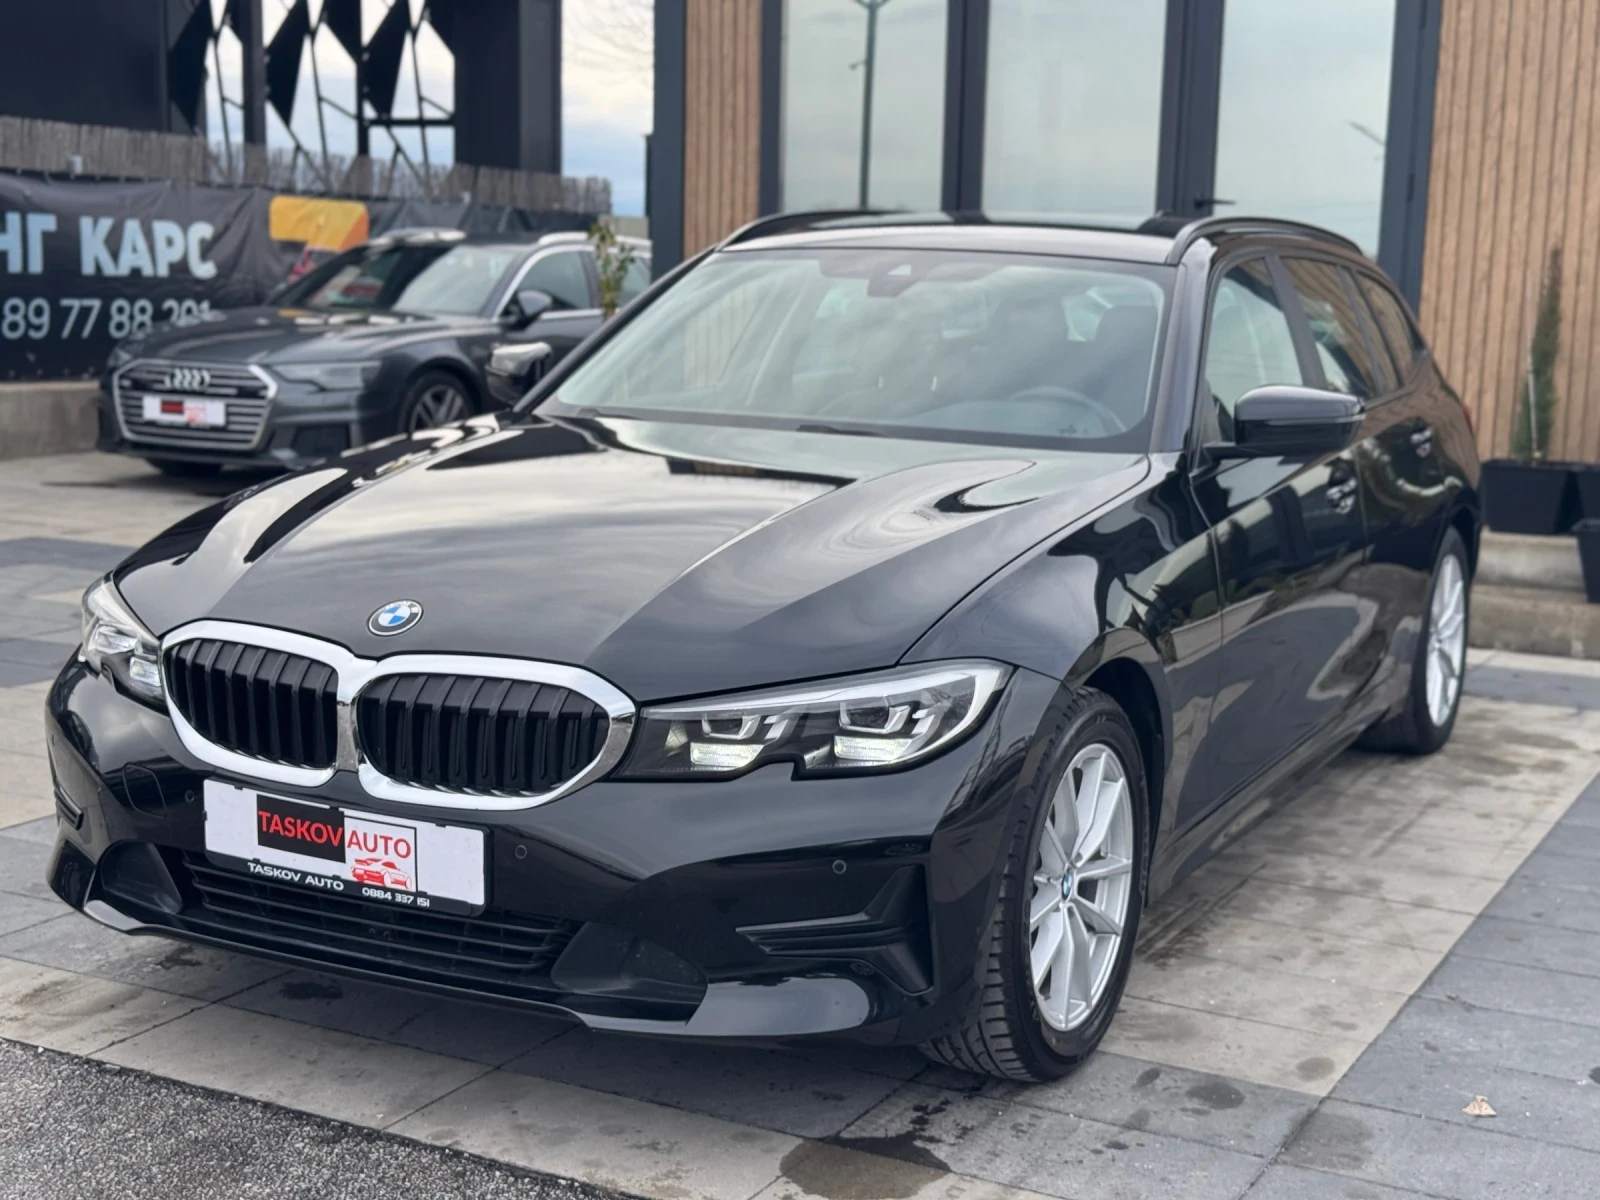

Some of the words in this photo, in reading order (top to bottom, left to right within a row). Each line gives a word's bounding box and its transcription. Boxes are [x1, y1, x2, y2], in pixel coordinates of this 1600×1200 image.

[79, 215, 218, 280] КАРС
[2, 297, 51, 340] 89
[59, 298, 103, 340] 77
[108, 298, 153, 341] 88
[258, 810, 343, 848] TASKOV
[347, 829, 412, 859] AUTO
[247, 862, 301, 882] TASKOV
[305, 875, 345, 891] AUTO
[362, 887, 393, 901] 0884
[395, 893, 415, 905] 337
